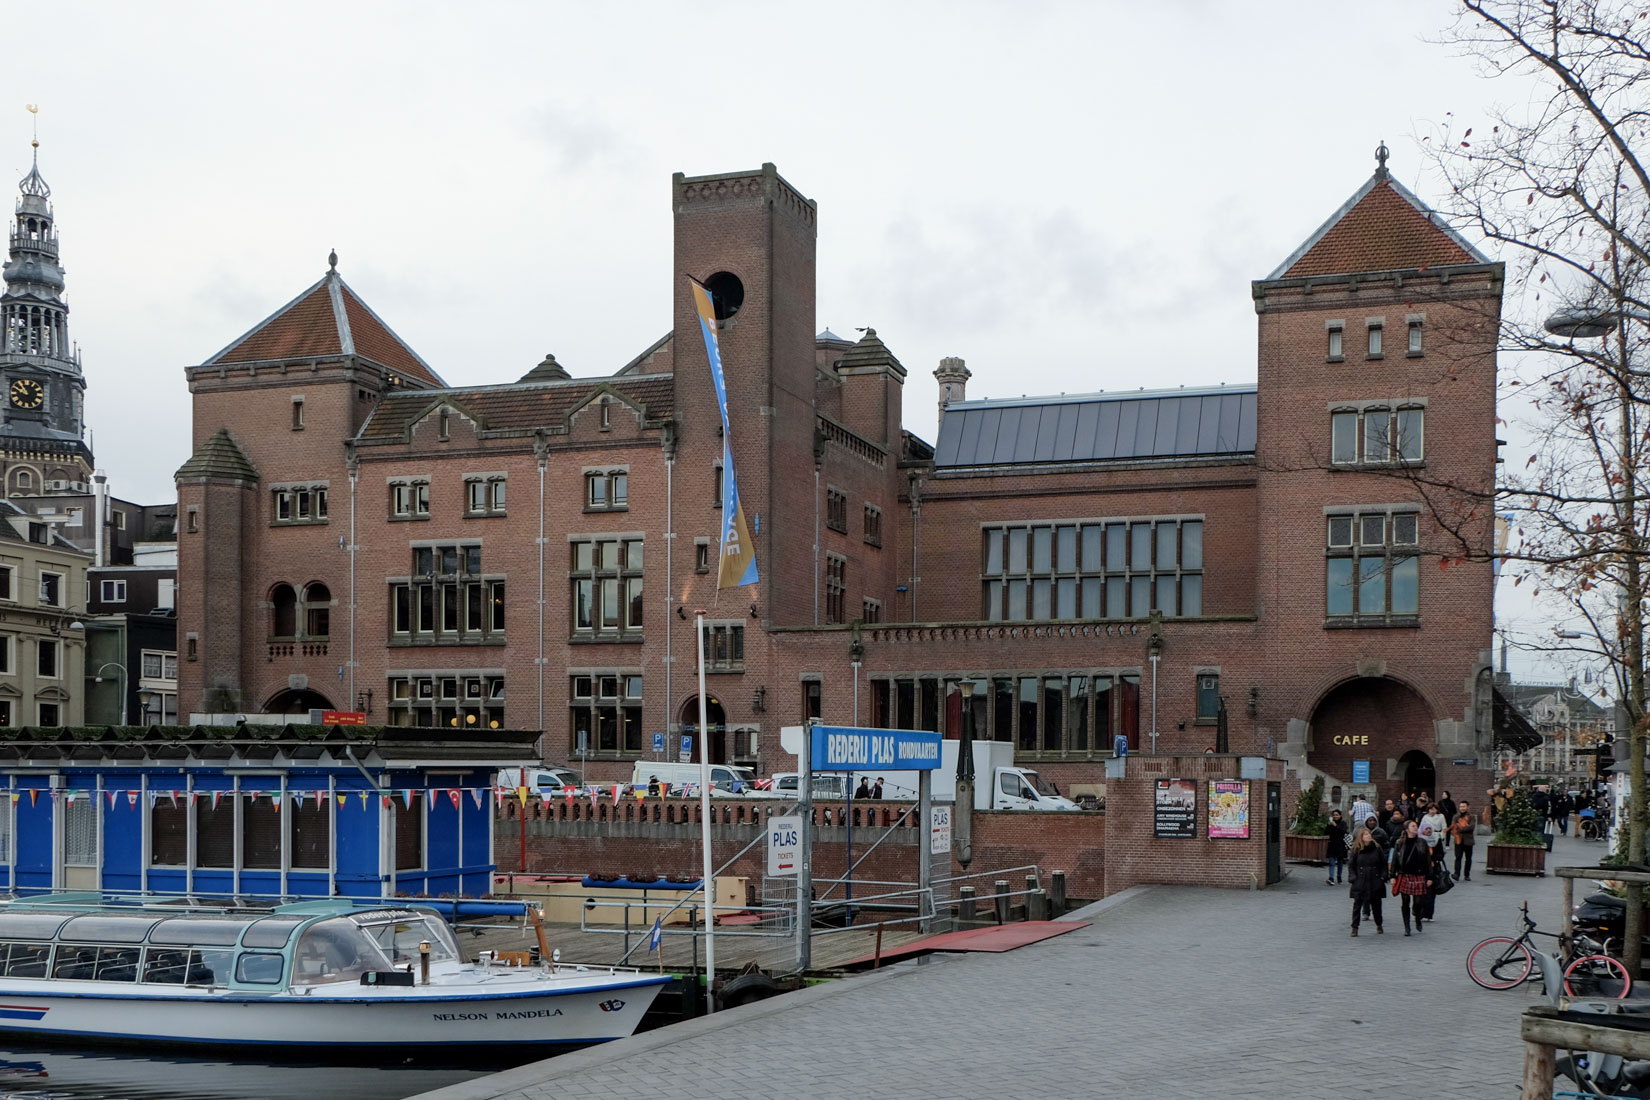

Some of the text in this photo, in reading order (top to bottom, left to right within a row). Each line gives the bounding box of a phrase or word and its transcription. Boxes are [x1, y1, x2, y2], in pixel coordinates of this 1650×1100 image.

[655, 734, 662, 742] P
[683, 737, 690, 746] P
[1333, 735, 1369, 745] CAFE
[828, 734, 939, 764] REDERIJ PLAS RONDVAARTEN
[1121, 740, 1127, 752] P
[934, 812, 948, 825] PLAS
[773, 831, 798, 847] PLAS
[777, 851, 794, 860] TICKETS
[433, 1008, 564, 1021] NELSON MANDELA
